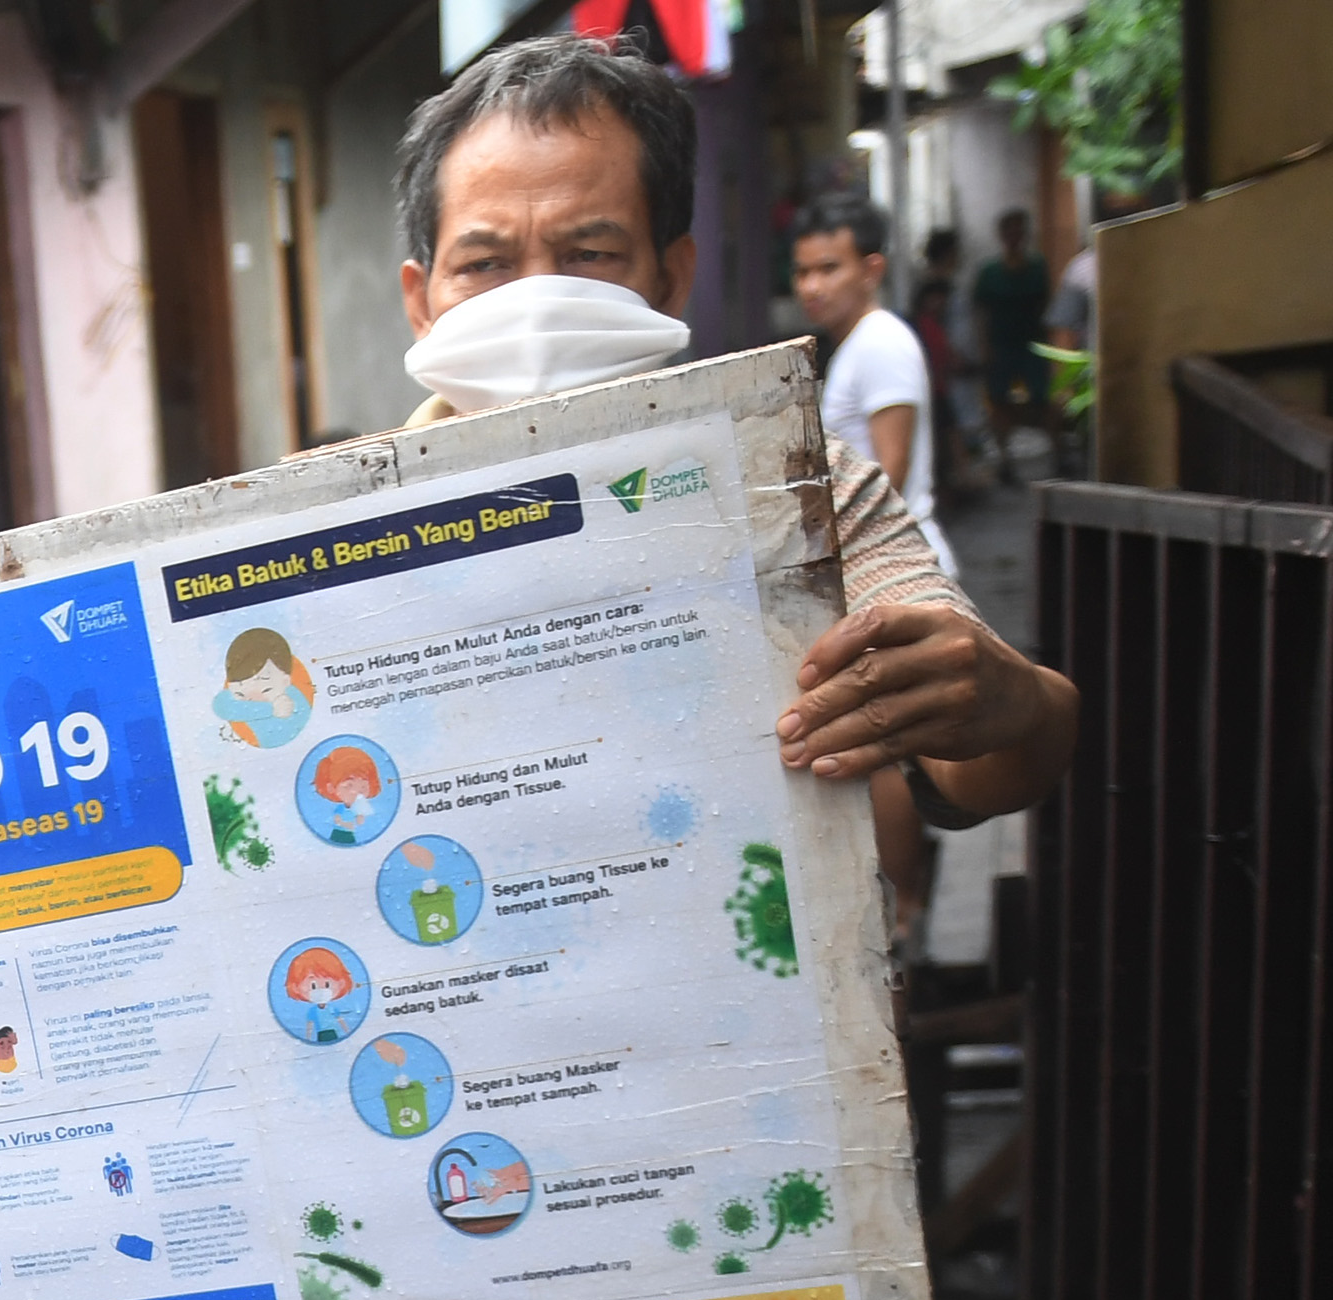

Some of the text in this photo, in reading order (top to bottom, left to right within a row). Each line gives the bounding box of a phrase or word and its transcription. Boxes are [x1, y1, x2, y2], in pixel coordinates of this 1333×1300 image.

[650, 465, 708, 490] DOMPET
[650, 479, 711, 503] DHUAFA
[174, 494, 555, 602] Etika Batuk & Bersin Yang Benar
[76, 600, 124, 622] DOMPET
[78, 612, 128, 633] DHUAFA
[323, 603, 644, 678] Tutup Hidung dan Mulut Anda dengan cara:
[19, 711, 110, 788] 19
[410, 752, 588, 796] Tutup Hidung dan Mulut
[72, 798, 104, 826] 19
[415, 779, 566, 816] Anda dengan Tissue.
[491, 856, 669, 898] Segera buang Tissue ke
[495, 885, 614, 917] tempat sampah.
[380, 960, 550, 999] Gunakan masker disaat
[384, 991, 484, 1018] sedang batuk.
[462, 1060, 621, 1094] Segera buang Masker
[465, 1081, 602, 1112] ke tempat sampah.
[8, 1131, 52, 1146] Virus
[55, 1121, 114, 1140] Corona
[542, 1165, 695, 1195] Lakukan cuci tangan
[546, 1188, 664, 1213] sesuai prosedur.
